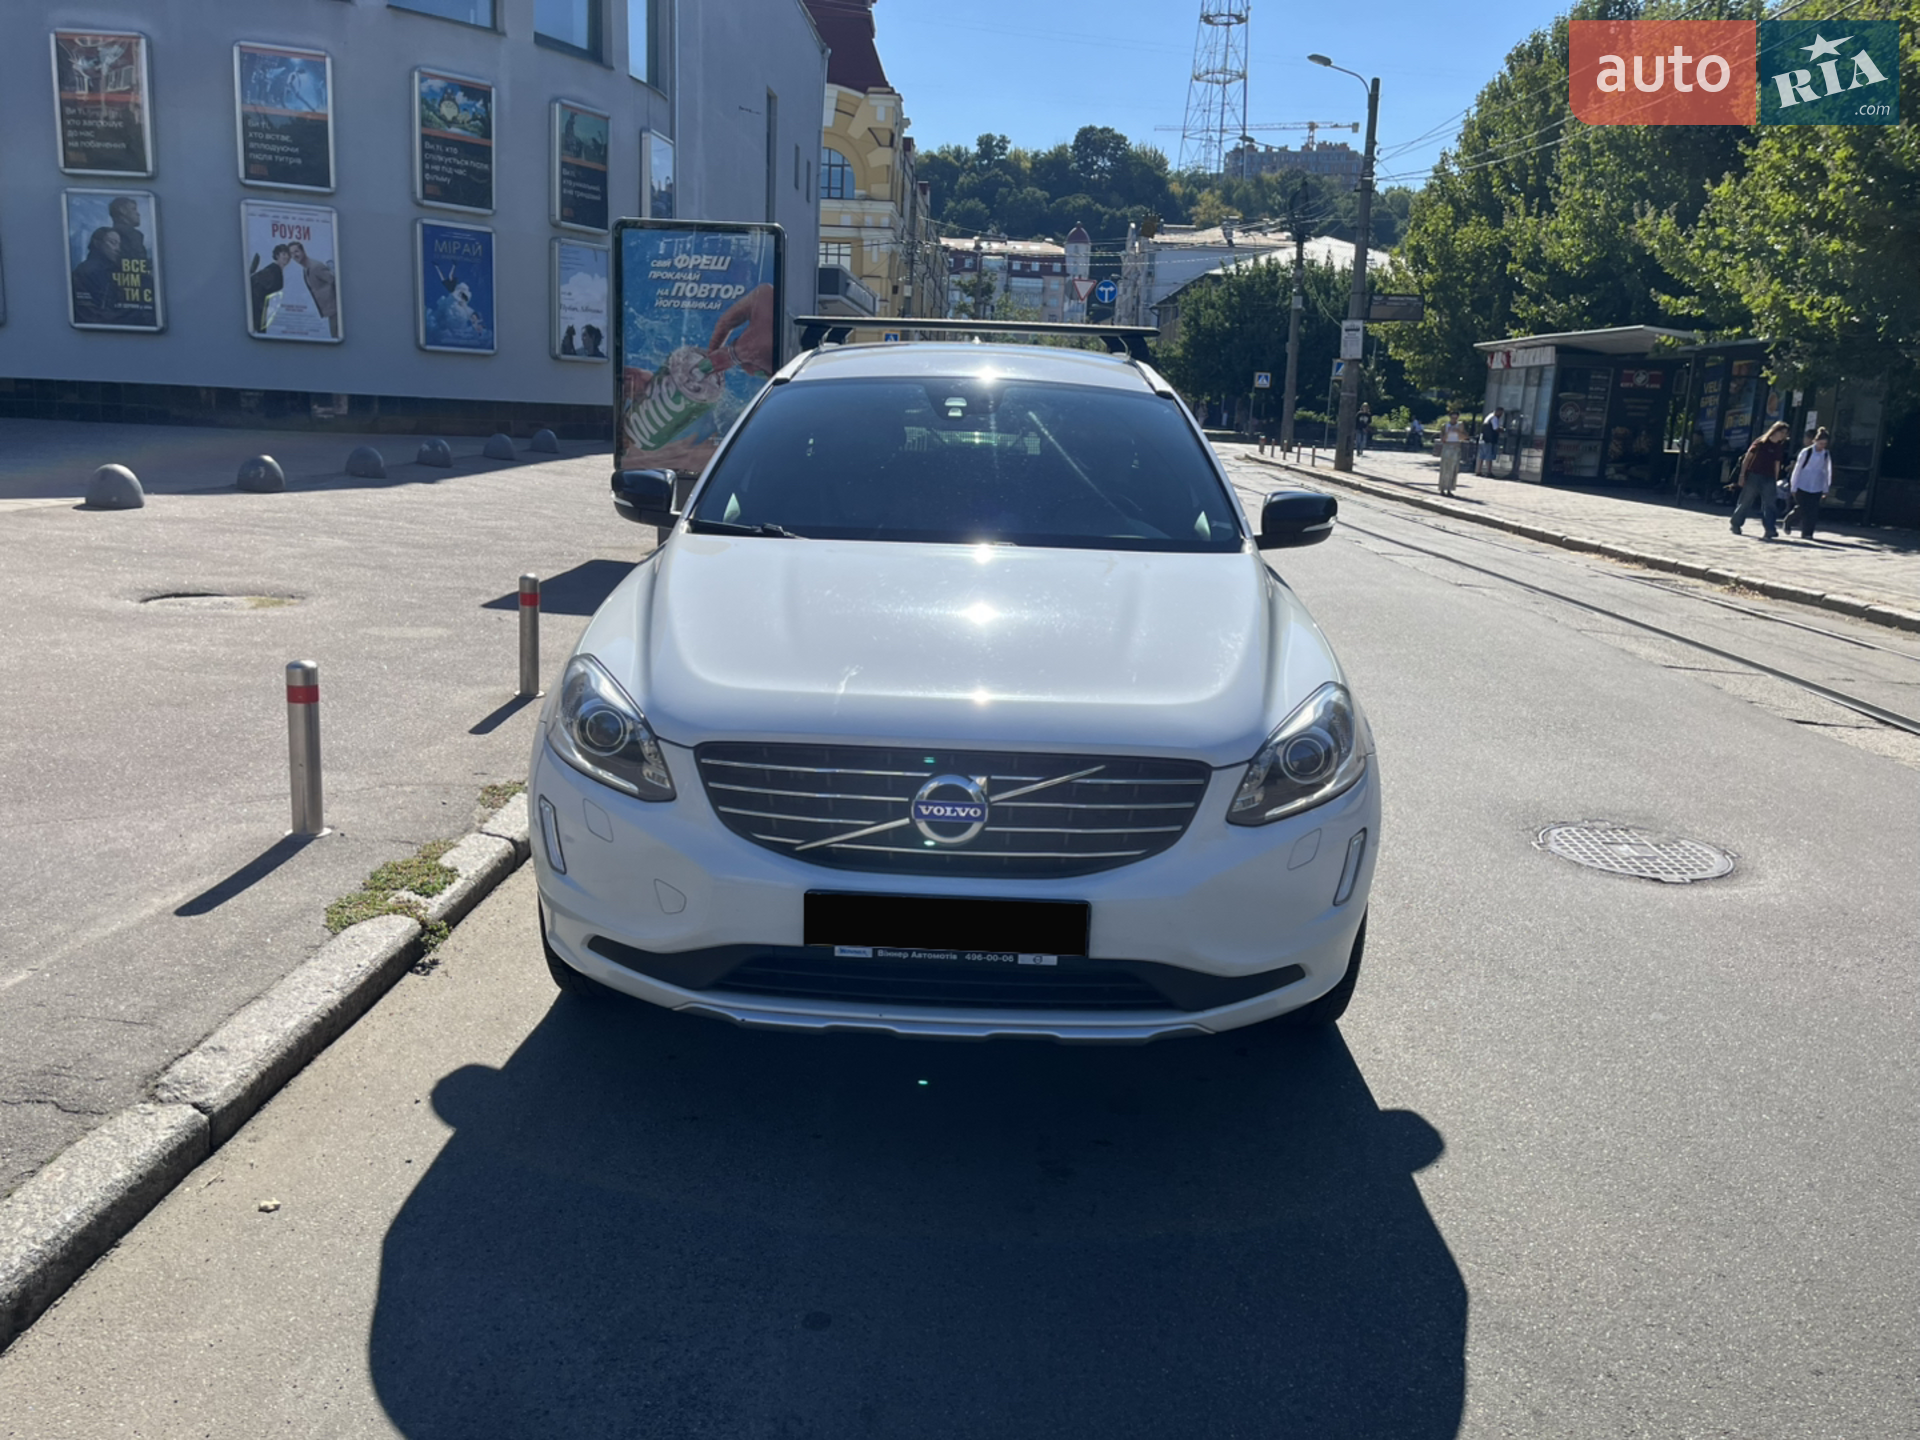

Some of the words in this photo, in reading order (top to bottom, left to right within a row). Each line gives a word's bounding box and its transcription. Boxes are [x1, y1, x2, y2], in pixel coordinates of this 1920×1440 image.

[271, 223, 311, 241] РОУЗИ
[434, 239, 483, 257] МІРАЙ
[122, 258, 152, 275] ВСЕ,
[674, 254, 732, 271] ФРЕШ
[112, 272, 141, 287] ЧИМ
[648, 270, 700, 281] ПРОКАЧАЙ
[124, 287, 140, 302] ТИ
[143, 288, 153, 303] Є
[655, 288, 670, 297] НА
[670, 282, 746, 300] ПОВТОР
[654, 297, 681, 308] ЙОГО
[680, 299, 722, 311] ВМИКАЙ
[917, 804, 982, 818] VOLVO
[877, 948, 909, 959] Віннер
[910, 951, 958, 961] Автомотів
[964, 953, 1014, 963] 496-00-06
